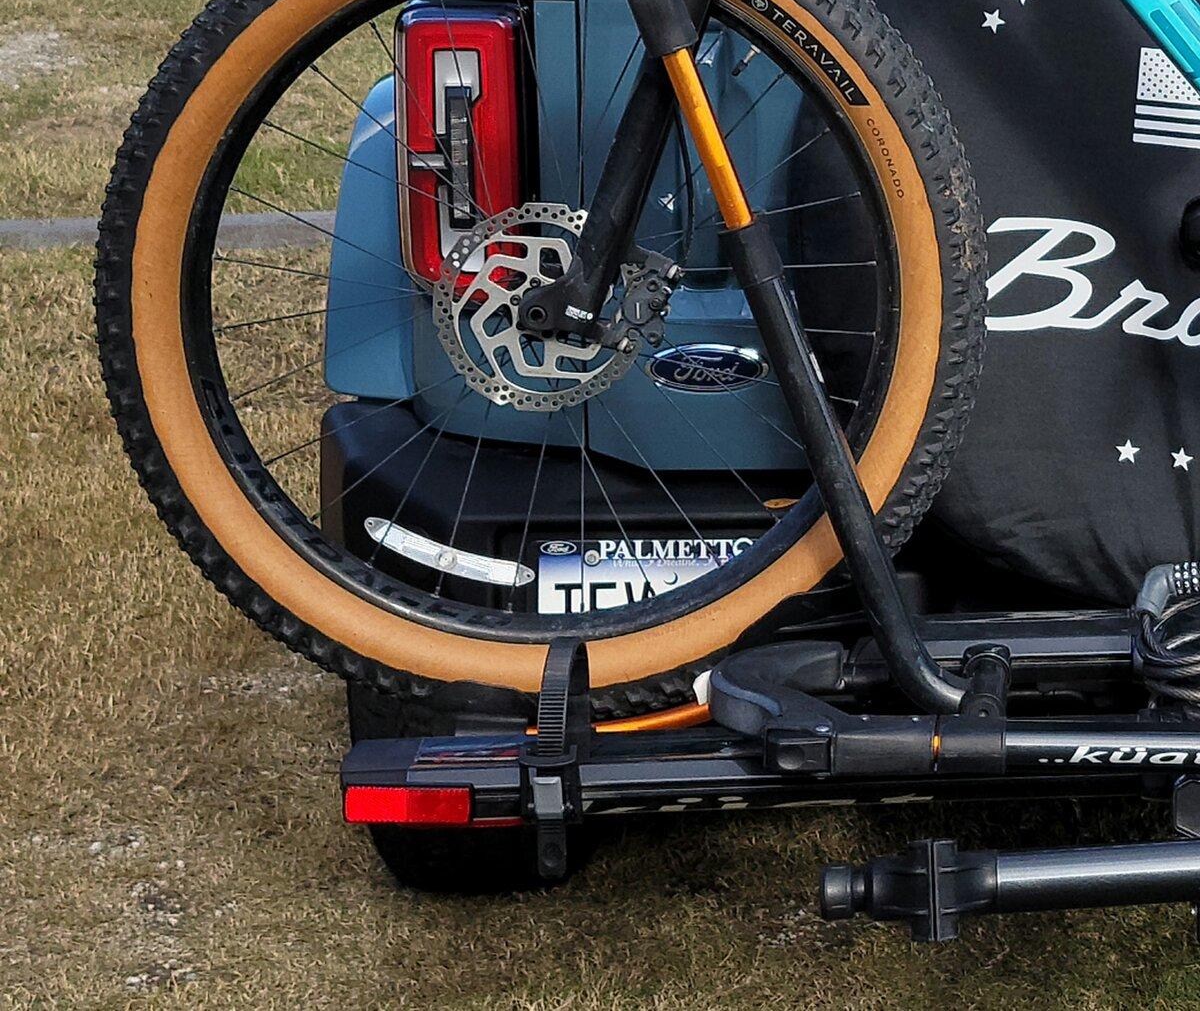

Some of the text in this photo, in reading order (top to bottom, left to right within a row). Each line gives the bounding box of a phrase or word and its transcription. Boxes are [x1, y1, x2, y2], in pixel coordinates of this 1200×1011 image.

[771, 7, 905, 200] TERAVAIL CORONADO
[673, 354, 741, 382] Ford
